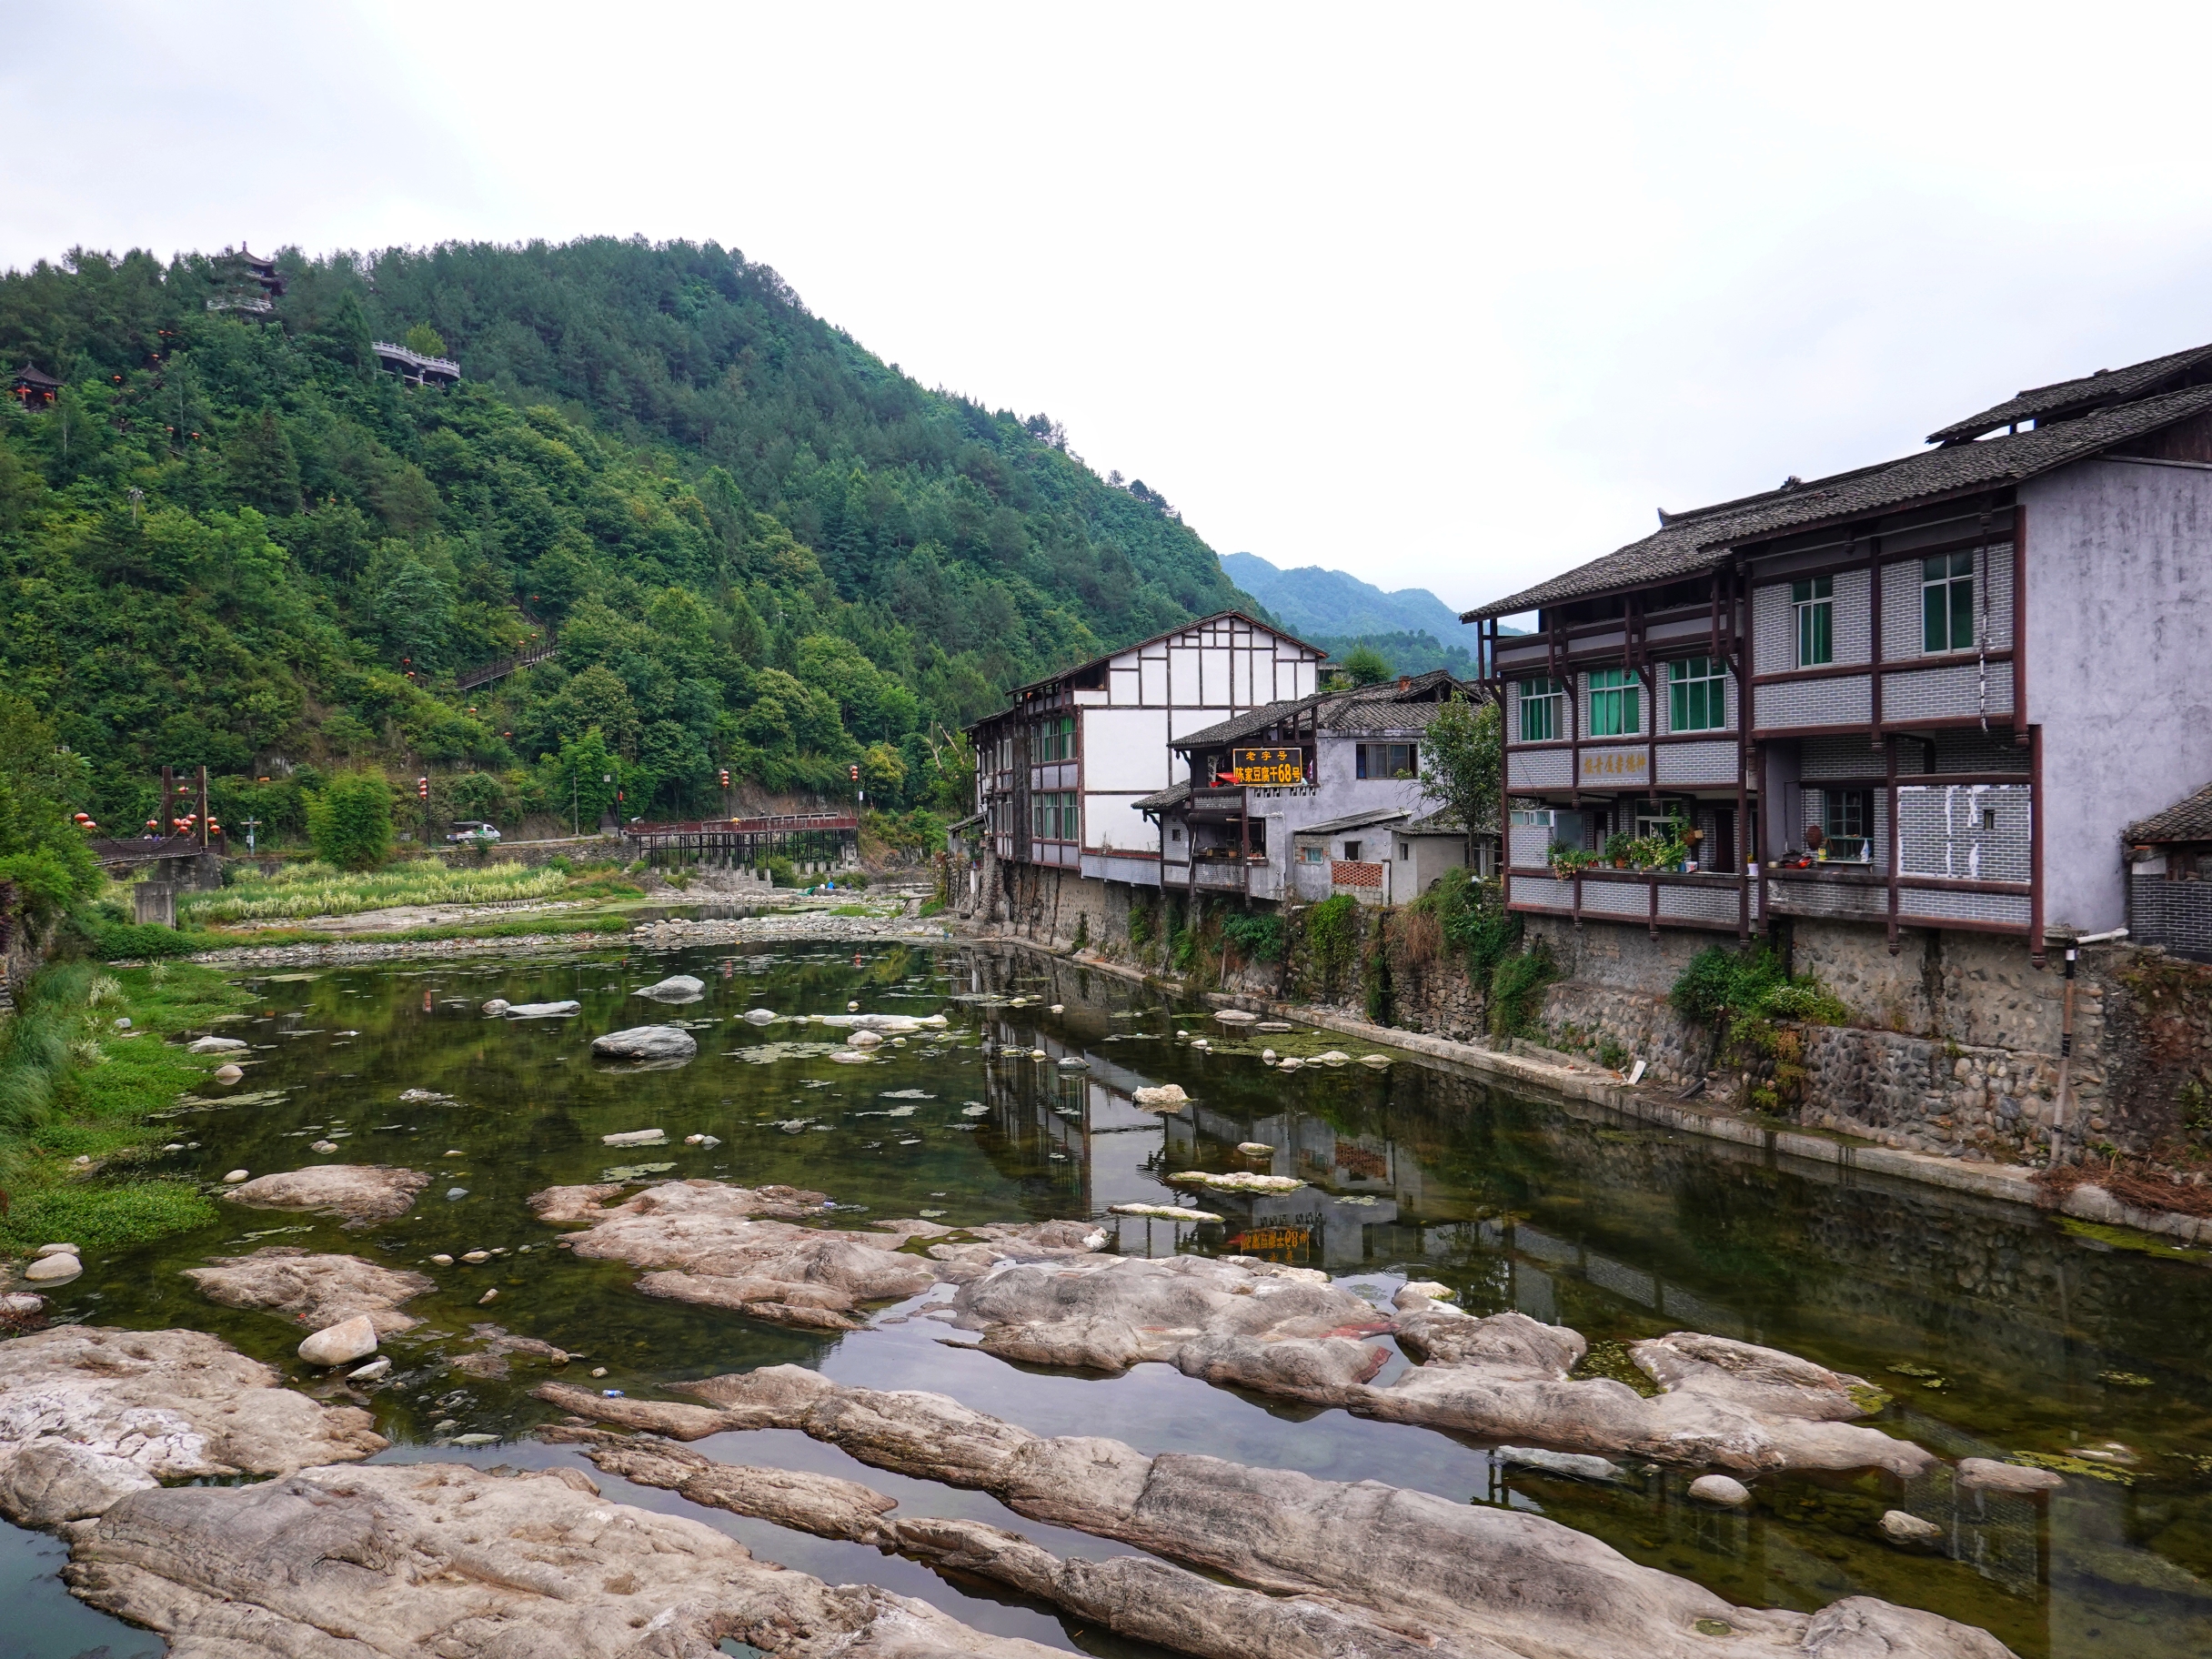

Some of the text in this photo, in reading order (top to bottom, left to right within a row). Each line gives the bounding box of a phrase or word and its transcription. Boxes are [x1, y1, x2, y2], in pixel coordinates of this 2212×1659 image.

[1245, 750, 1288, 761] 老字号
[1235, 764, 1301, 782] 陈家豆腐干68号
